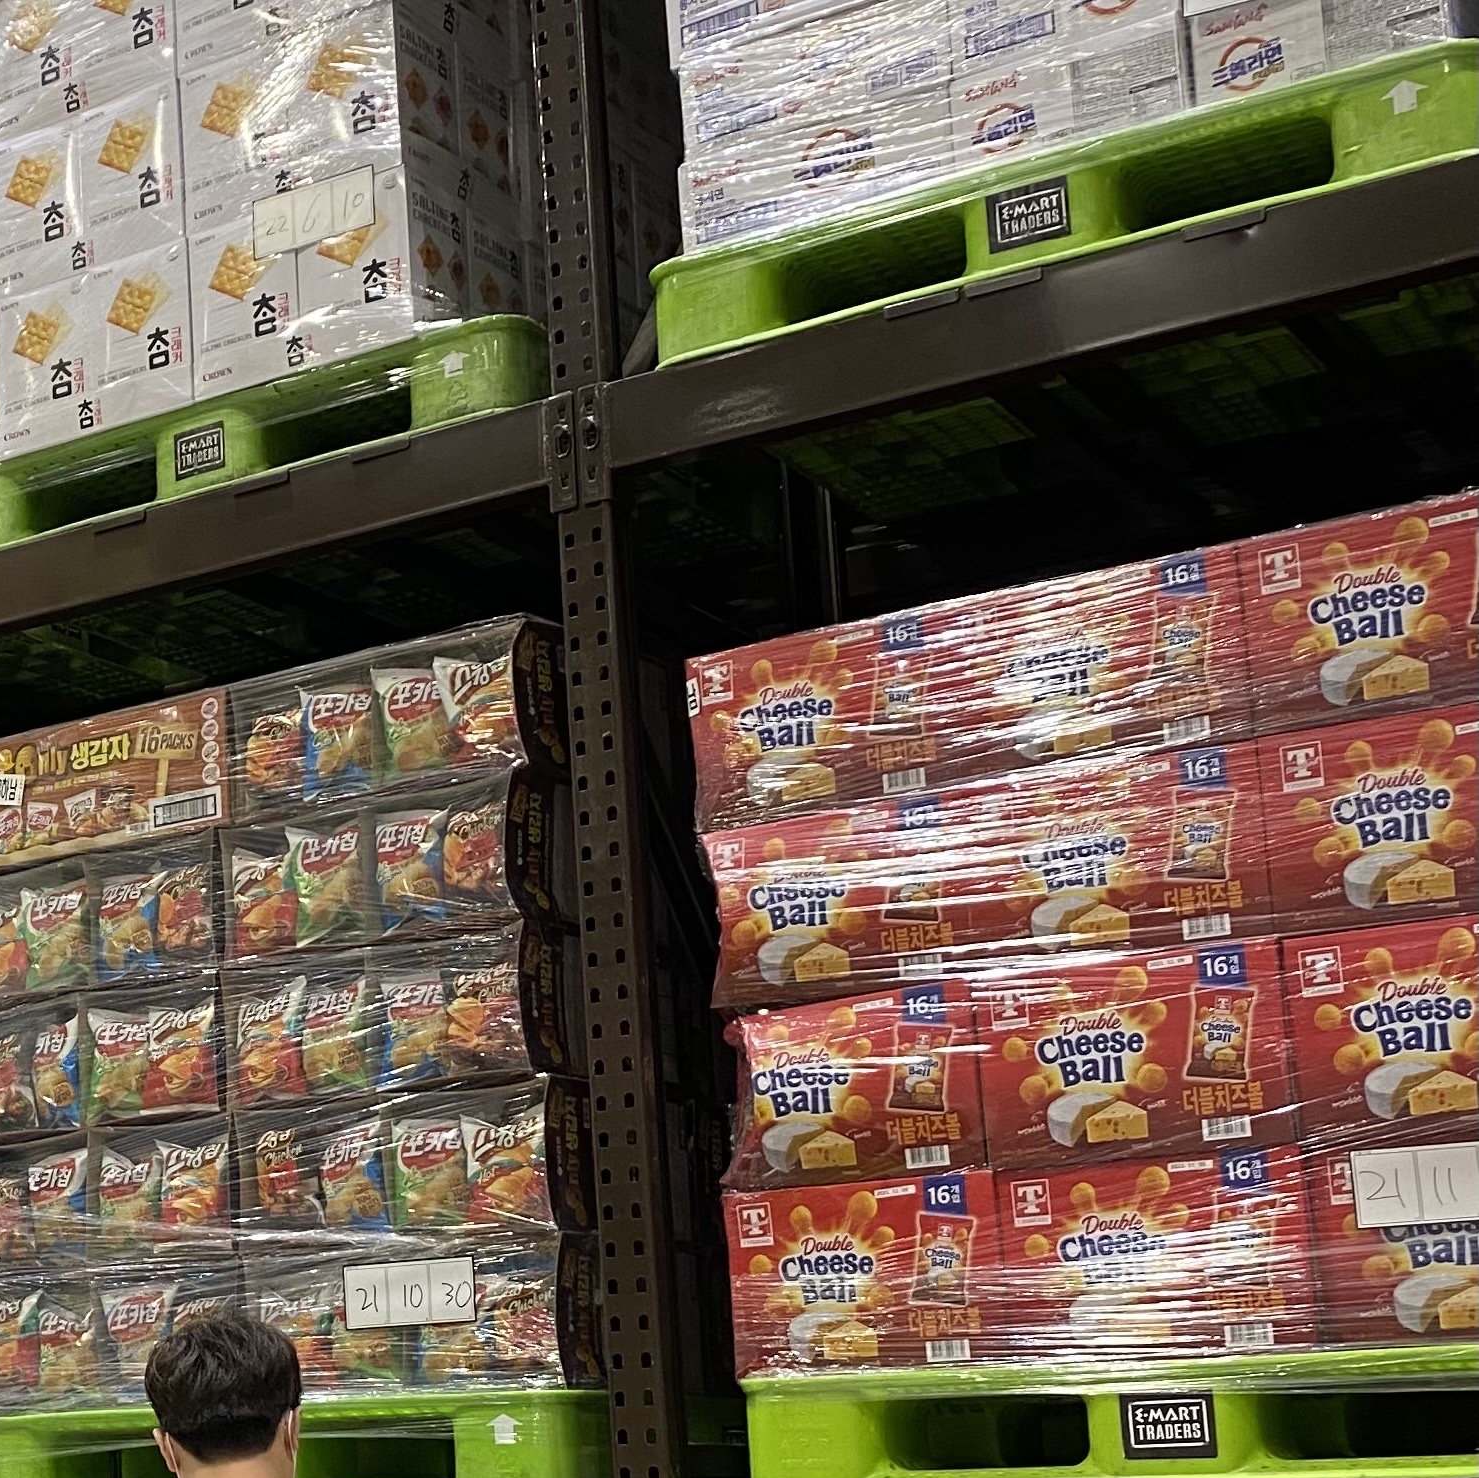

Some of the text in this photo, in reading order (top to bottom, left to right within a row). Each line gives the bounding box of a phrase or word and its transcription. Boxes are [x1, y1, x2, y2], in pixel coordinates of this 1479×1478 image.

[132, 6, 154, 49] 참
[40, 45, 61, 86] 참
[138, 166, 161, 209] 참
[266, 191, 364, 236] 22 10
[1003, 211, 1060, 236] TRADERS
[252, 292, 277, 338] 참
[147, 327, 170, 370] 참
[171, 326, 183, 364] 크래커
[286, 335, 305, 368] 참
[50, 358, 72, 400] 참
[73, 357, 85, 395] 크래커
[181, 447, 219, 468] TRADERS
[1334, 564, 1401, 594] Double
[1310, 582, 1426, 625] Cheese
[1332, 610, 1404, 647] Ball
[315, 692, 372, 716] 포카칩
[759, 681, 813, 705] Double
[739, 697, 833, 732] Cheese
[70, 733, 130, 770] 생감자
[140, 726, 195, 754] 16 PACKS
[757, 721, 815, 751] Ball
[1184, 759, 1210, 780] 16
[1357, 768, 1426, 793] Double
[1332, 786, 1451, 826] Cheese
[303, 831, 360, 863] 포카칩
[378, 822, 426, 852] 포카칩
[1356, 812, 1430, 850] Ball
[1163, 880, 1243, 916] 더블치즈볼
[768, 899, 828, 932] Ball
[1203, 956, 1228, 977] 16
[1377, 975, 1447, 1001] Double
[1058, 1010, 1123, 1035] Double
[1352, 995, 1473, 1033] Cheese
[1037, 1030, 1145, 1064] Cheese
[1379, 1022, 1451, 1057] Ball
[1059, 1054, 1125, 1088] Ball
[769, 1087, 833, 1118] Ball
[1182, 1081, 1263, 1116] 더블치즈볼
[401, 1129, 462, 1158] 포카칩
[886, 1112, 962, 1145] 더블치즈볼
[321, 1136, 364, 1167] 포카칩
[1225, 1159, 1250, 1181] 16
[926, 1184, 949, 1206] 16
[1359, 1170, 1404, 1208] 21
[800, 1234, 854, 1255] Double
[780, 1252, 874, 1281] Cheese
[356, 1282, 471, 1311] 21 10 30
[109, 1302, 161, 1331] 포카칩
[1136, 1422, 1201, 1440] TRADERS
